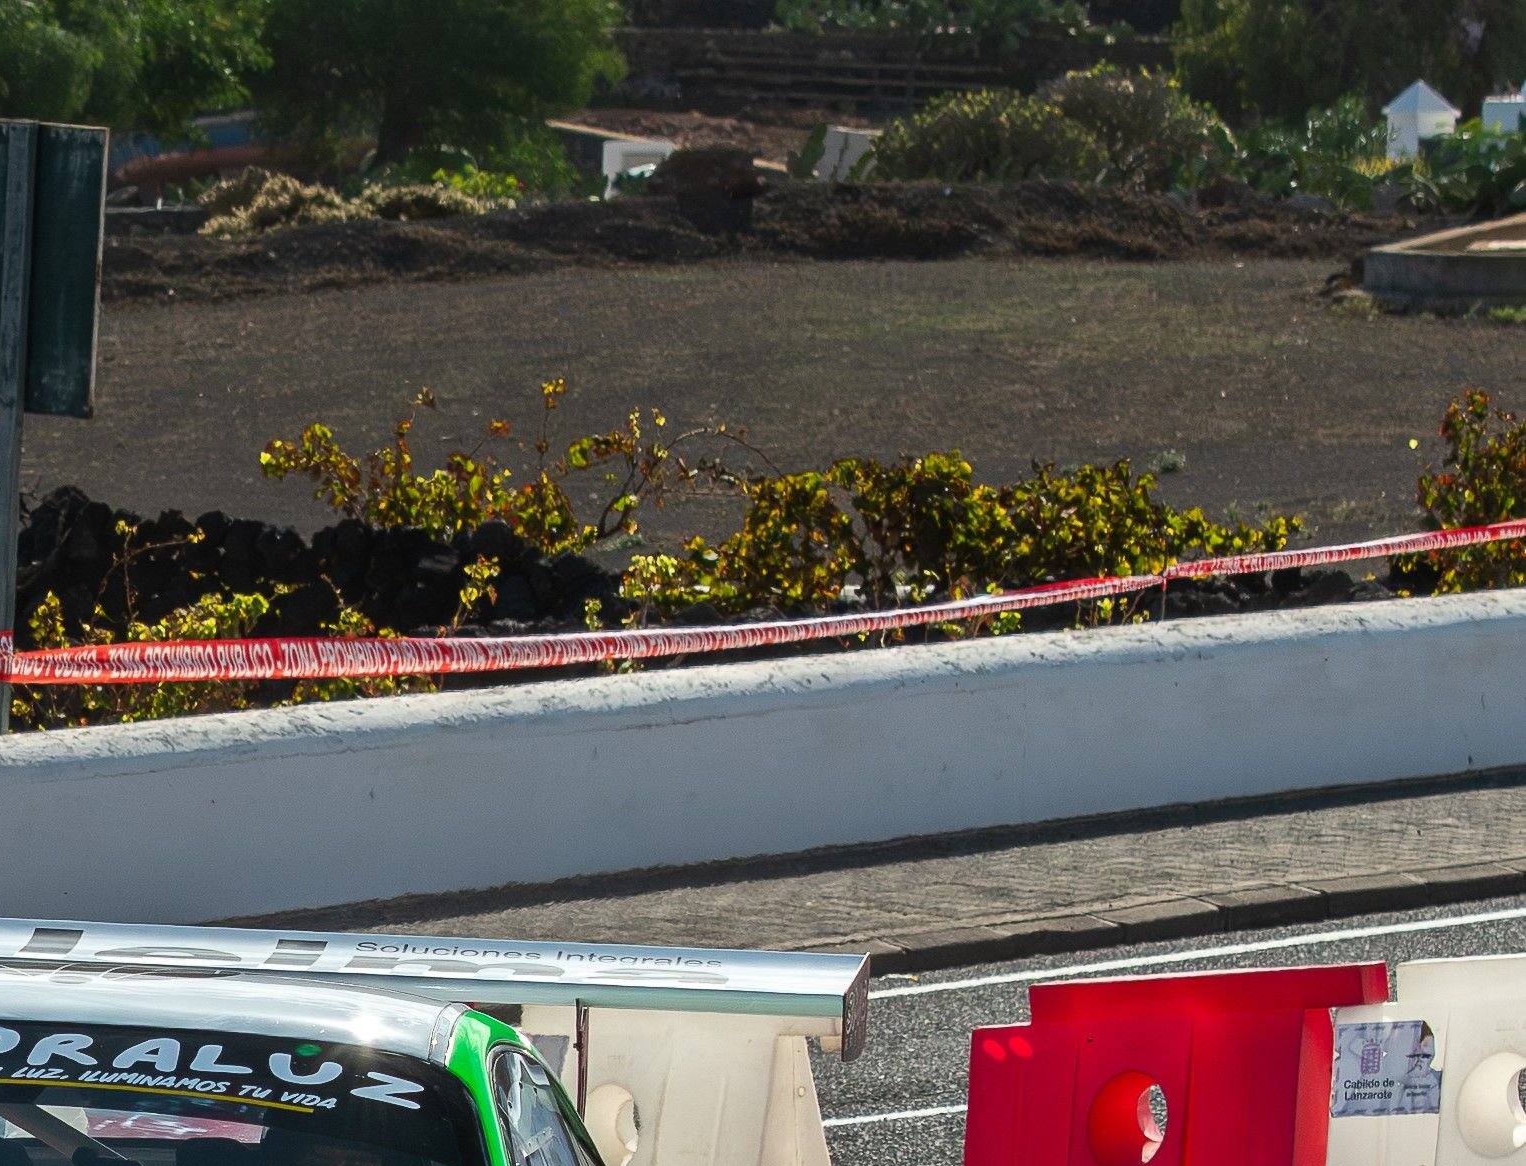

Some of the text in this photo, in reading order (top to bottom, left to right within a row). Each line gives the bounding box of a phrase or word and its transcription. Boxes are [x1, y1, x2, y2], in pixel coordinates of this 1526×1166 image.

[356, 942, 723, 968] Soluciones Integrales
[78, 1071, 231, 1093] ILUMINAMOS
[241, 1086, 273, 1099] TU
[281, 1091, 338, 1109] VIDA
[1344, 1078, 1381, 1090] Cabildo
[1382, 1077, 1395, 1088] de
[1344, 1090, 1392, 1102] Lanzarote
